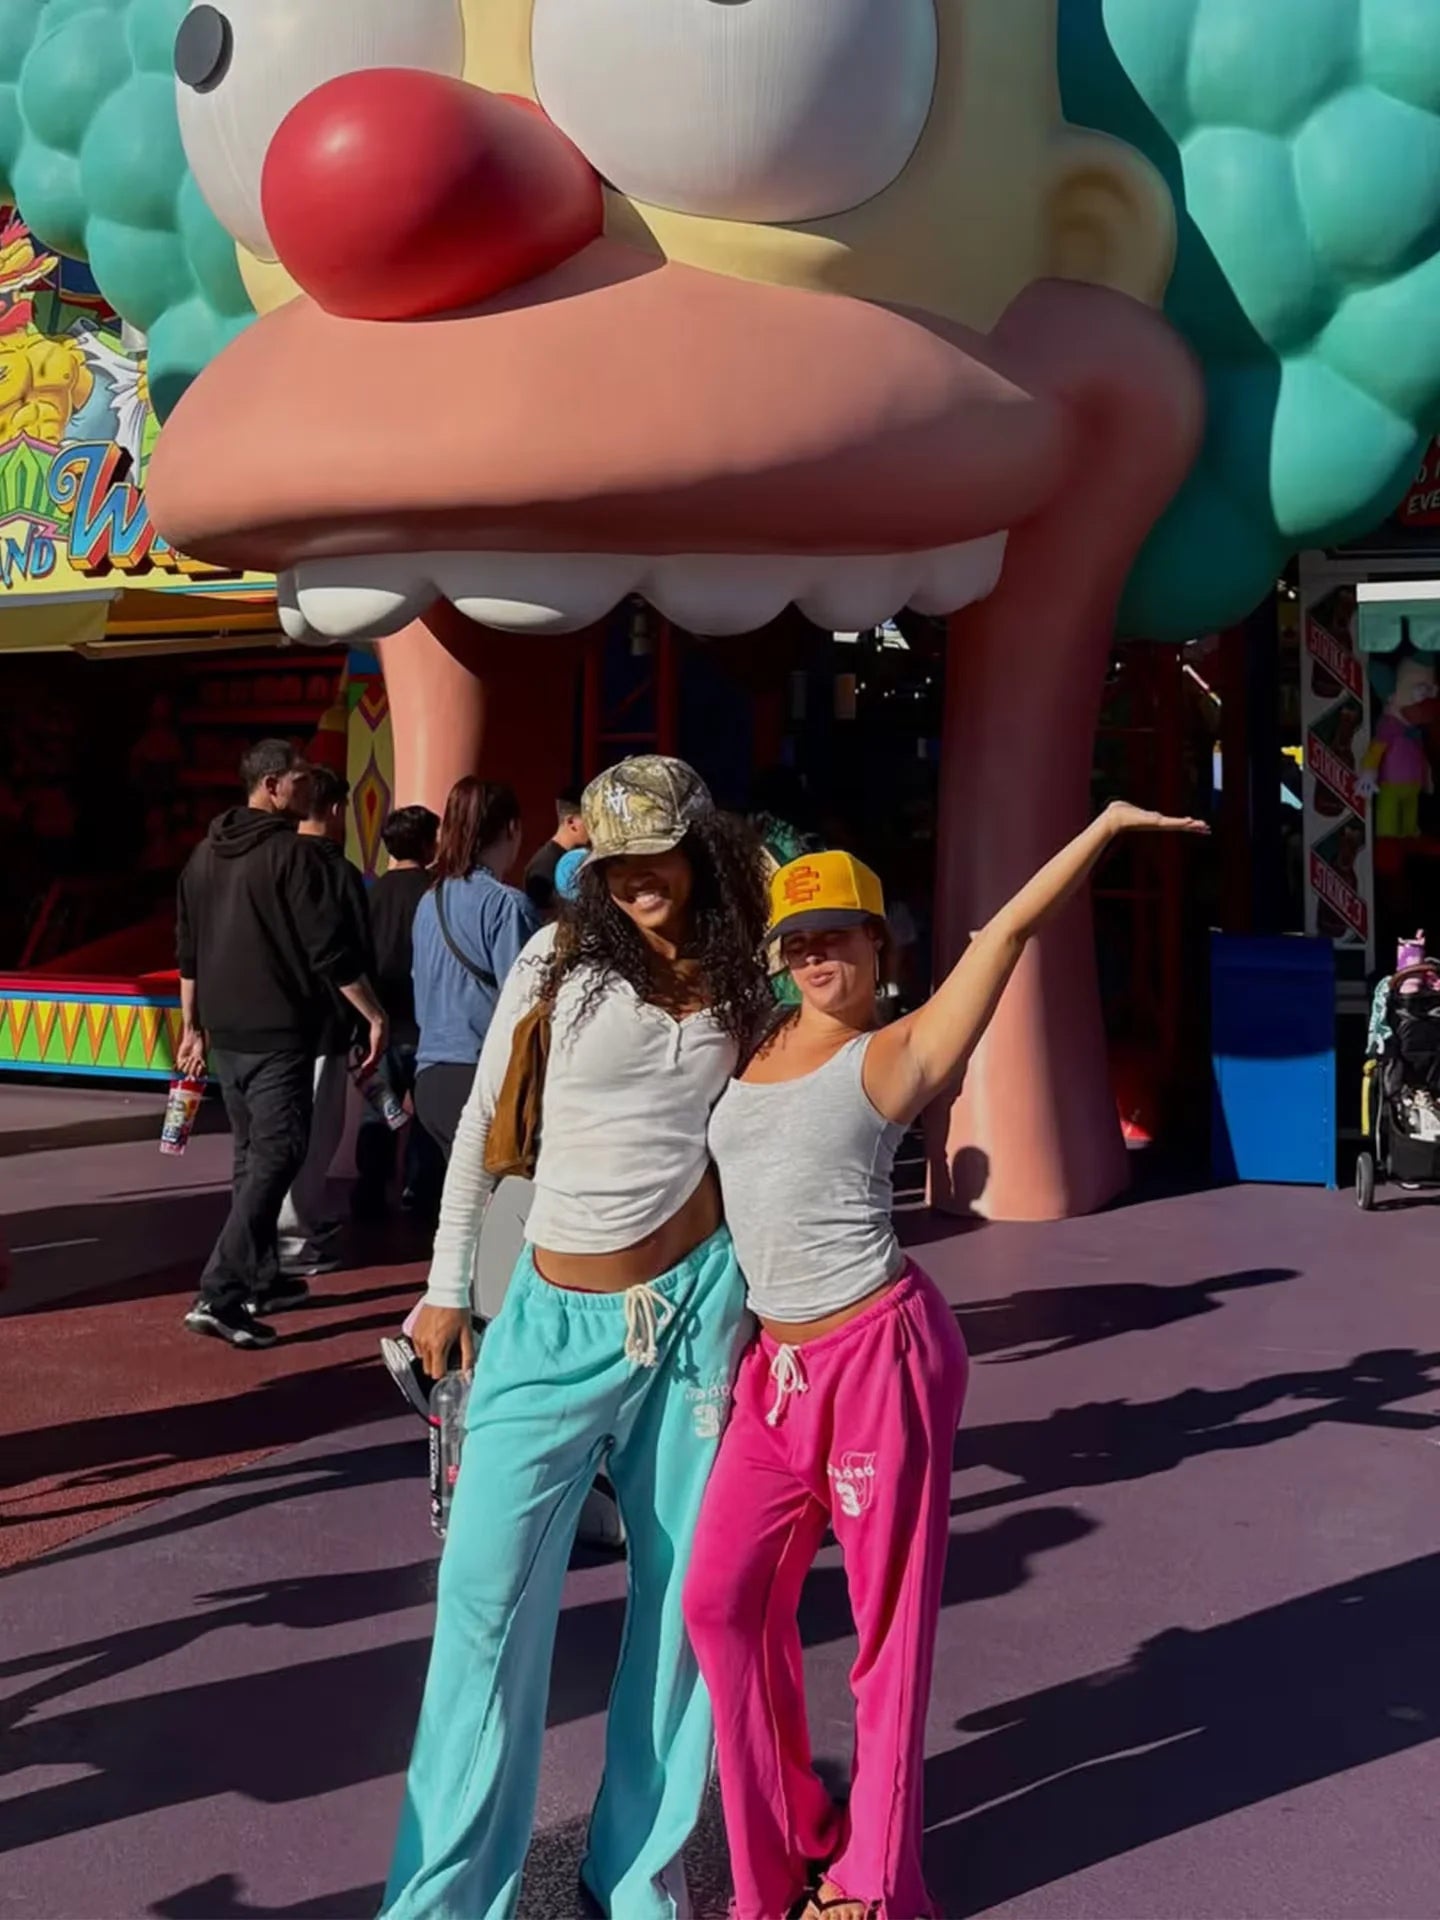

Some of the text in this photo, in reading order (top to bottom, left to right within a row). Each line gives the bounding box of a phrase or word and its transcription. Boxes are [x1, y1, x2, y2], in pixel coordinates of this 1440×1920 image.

[0, 523, 57, 590] ND
[1310, 624, 1348, 680] STRIKE
[1312, 740, 1350, 800] STRIKE
[1313, 860, 1352, 920] STRIKE
